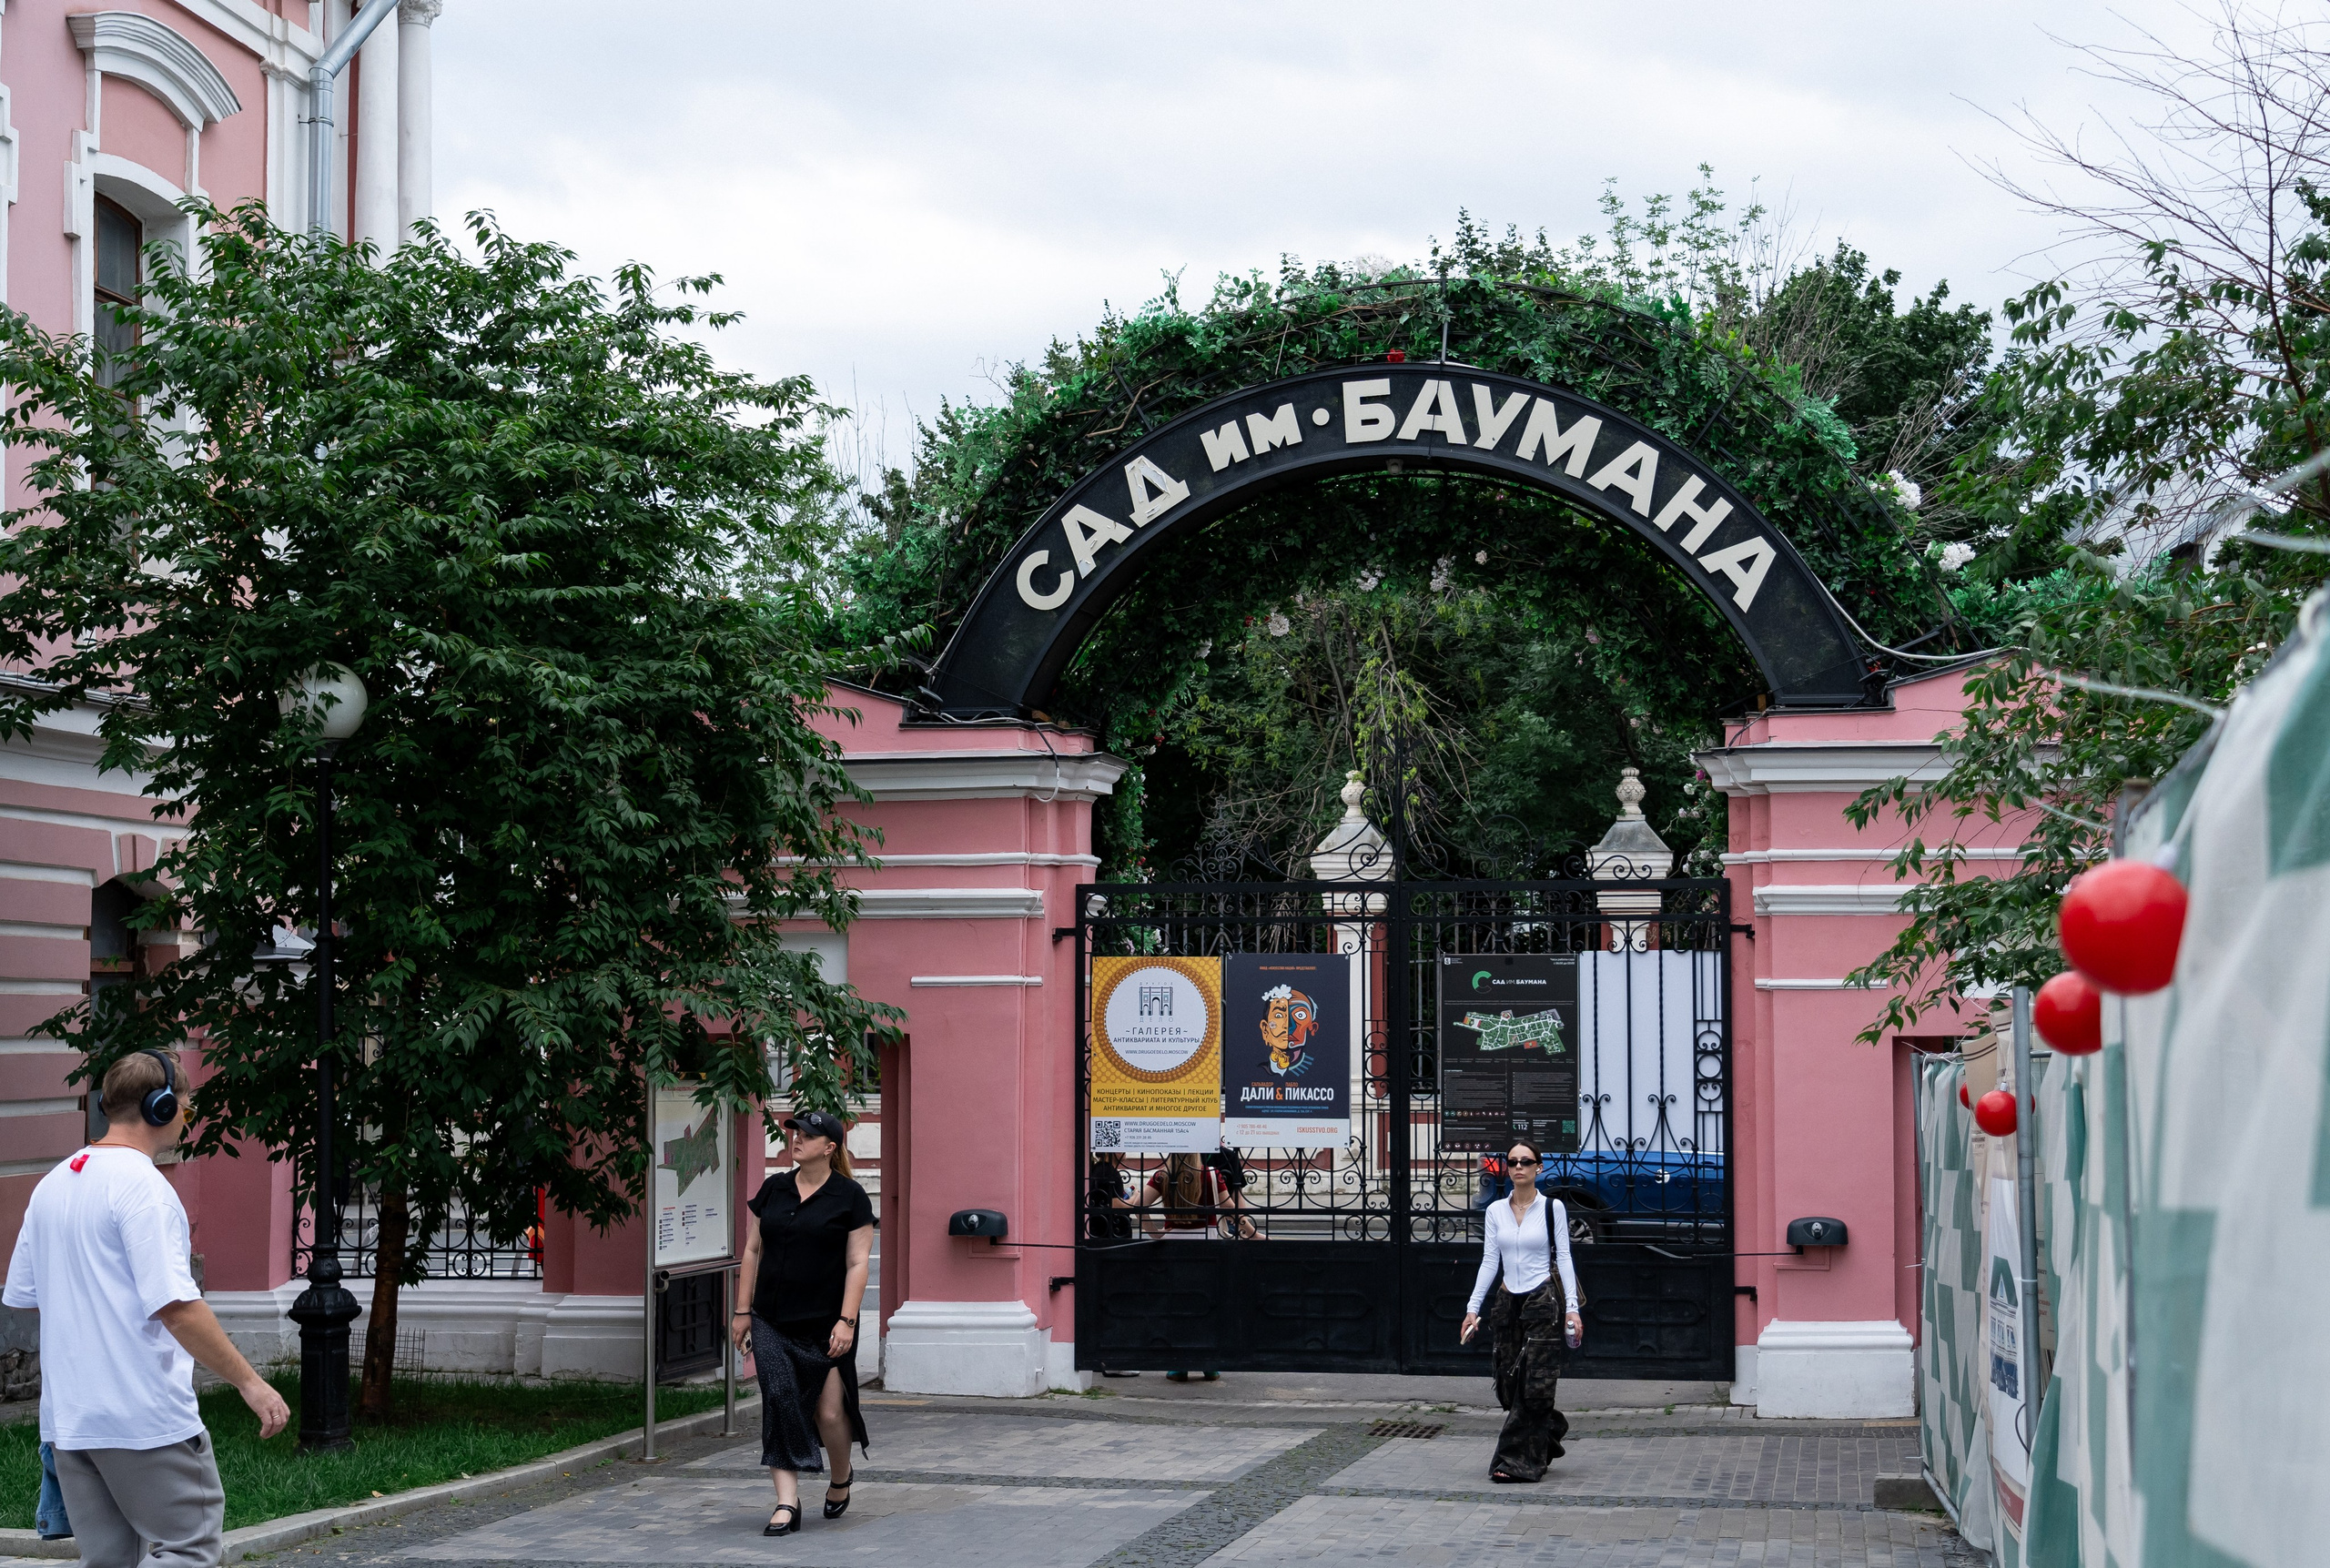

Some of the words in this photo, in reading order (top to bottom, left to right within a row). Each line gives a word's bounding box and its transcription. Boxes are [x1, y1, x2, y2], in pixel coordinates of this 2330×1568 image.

[1016, 454, 1191, 611] САД
[1342, 378, 1778, 614] БАУМАНА
[1241, 1087, 1274, 1101] ДАЛИ
[1276, 1087, 1283, 1100] &
[1285, 1087, 1334, 1100] ПИКАССО
